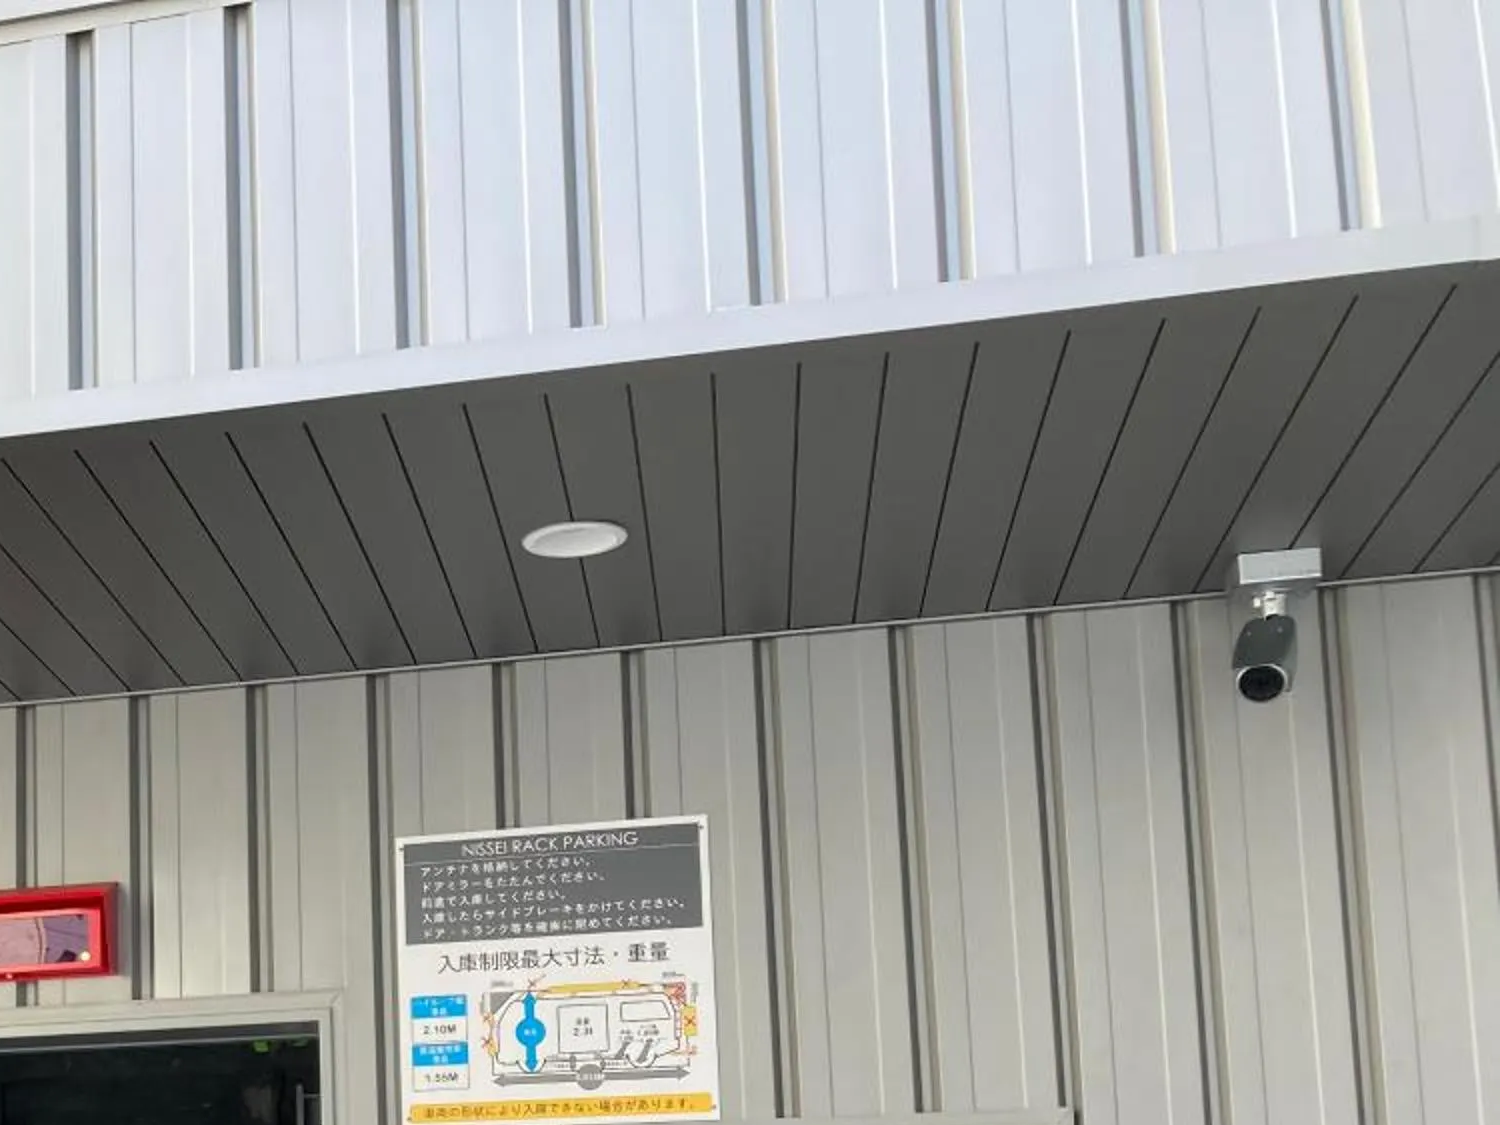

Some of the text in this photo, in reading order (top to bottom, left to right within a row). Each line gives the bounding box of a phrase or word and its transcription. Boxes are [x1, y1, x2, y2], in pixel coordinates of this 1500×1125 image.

[461, 831, 640, 857] NISSEI RACK PARKING
[438, 941, 671, 973] 入庫制限最大寸法・重量
